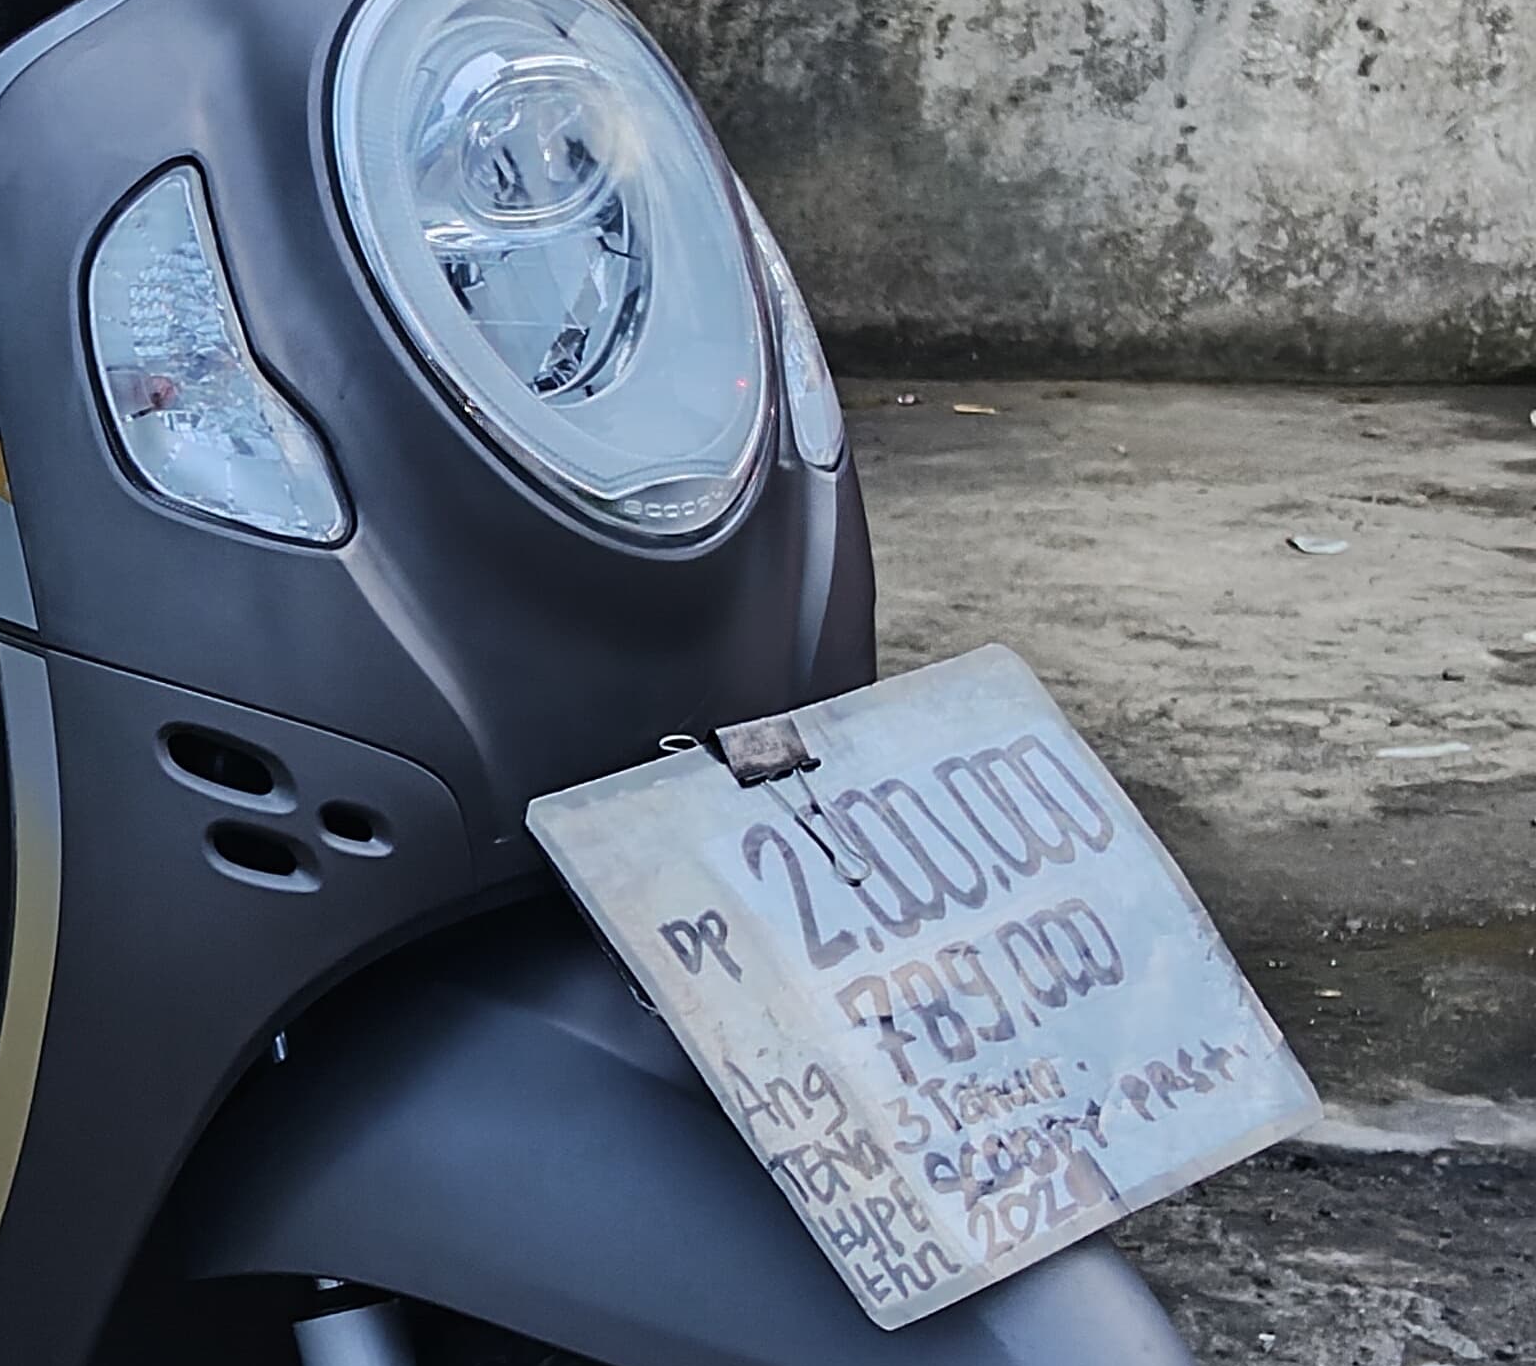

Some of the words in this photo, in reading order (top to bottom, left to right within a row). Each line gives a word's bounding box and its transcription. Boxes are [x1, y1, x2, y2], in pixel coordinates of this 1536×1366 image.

[657, 909, 743, 984] DP
[721, 1060, 849, 1145] Ang
[883, 1096, 932, 1154] 3
